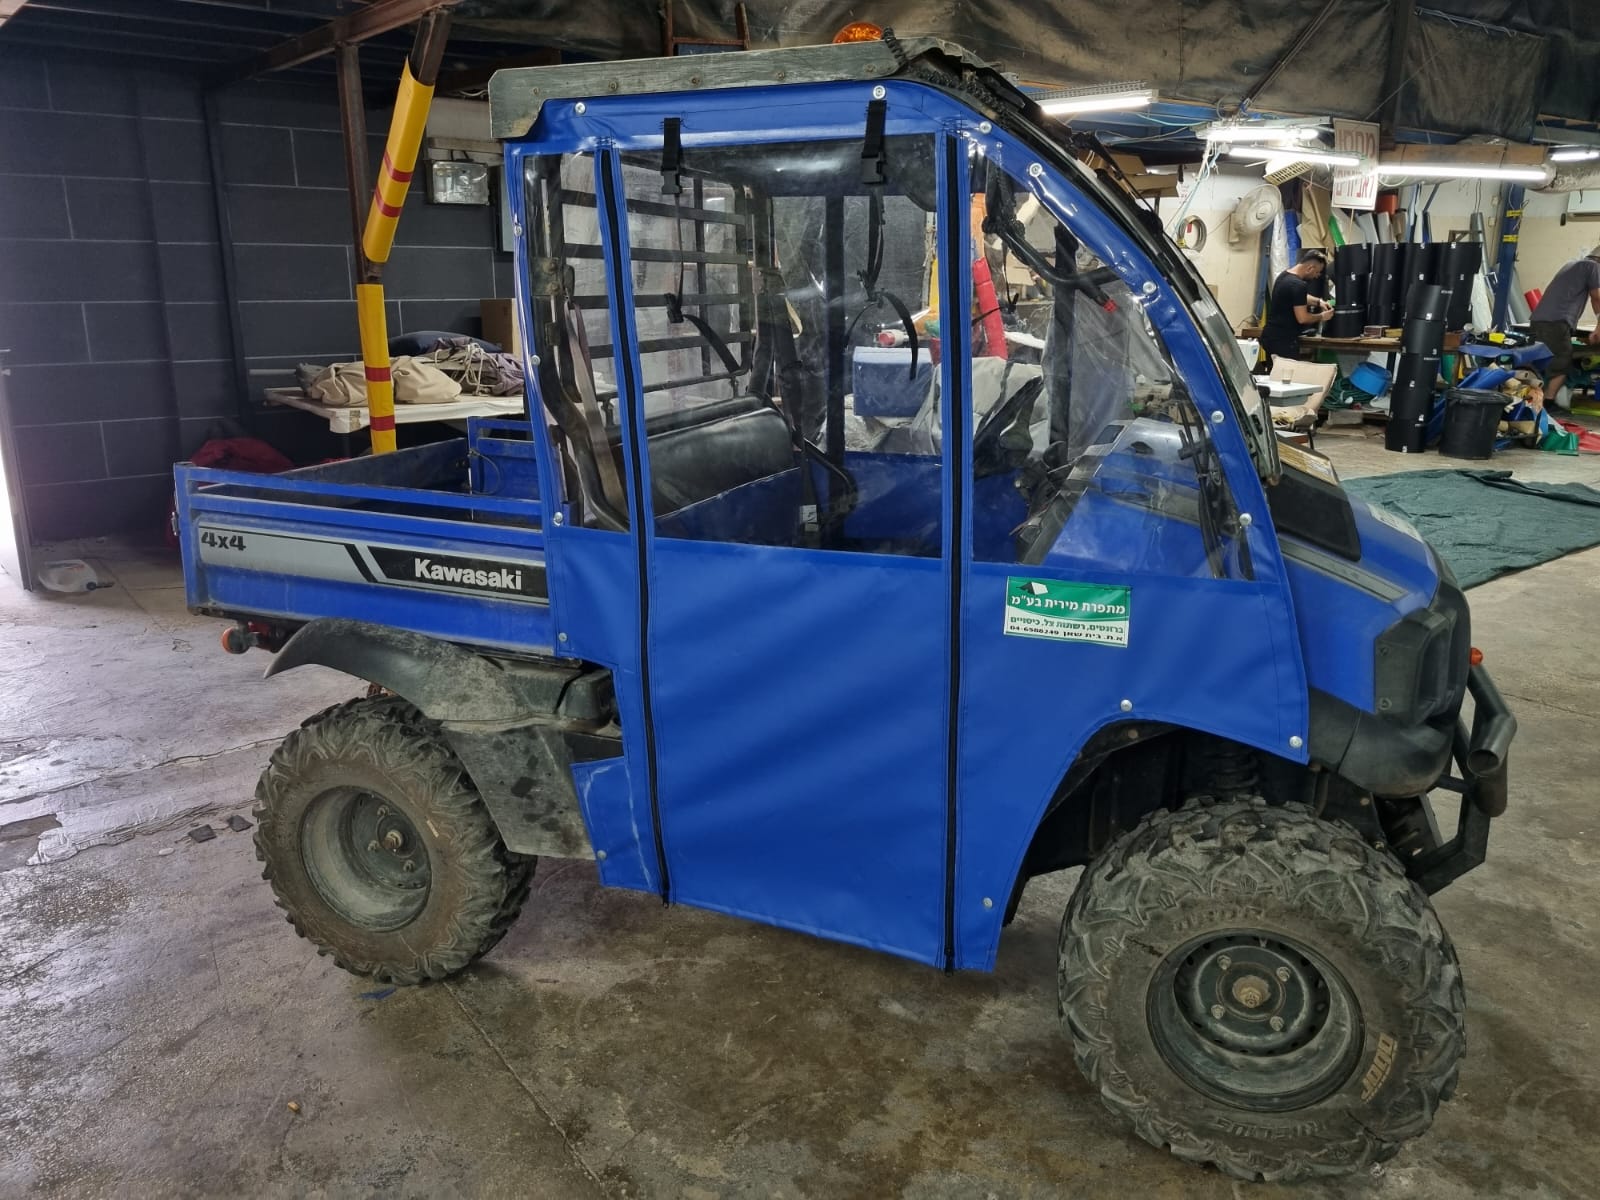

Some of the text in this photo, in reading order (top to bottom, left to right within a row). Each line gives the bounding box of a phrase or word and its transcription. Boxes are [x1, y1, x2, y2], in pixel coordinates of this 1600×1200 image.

[201, 531, 247, 551] 4x4
[414, 558, 522, 590] Kawasaki
[1011, 595, 1126, 615] מתפרת מירית בע"מ
[1010, 616, 1041, 626] כיסויים
[1056, 621, 1086, 631] רשתות
